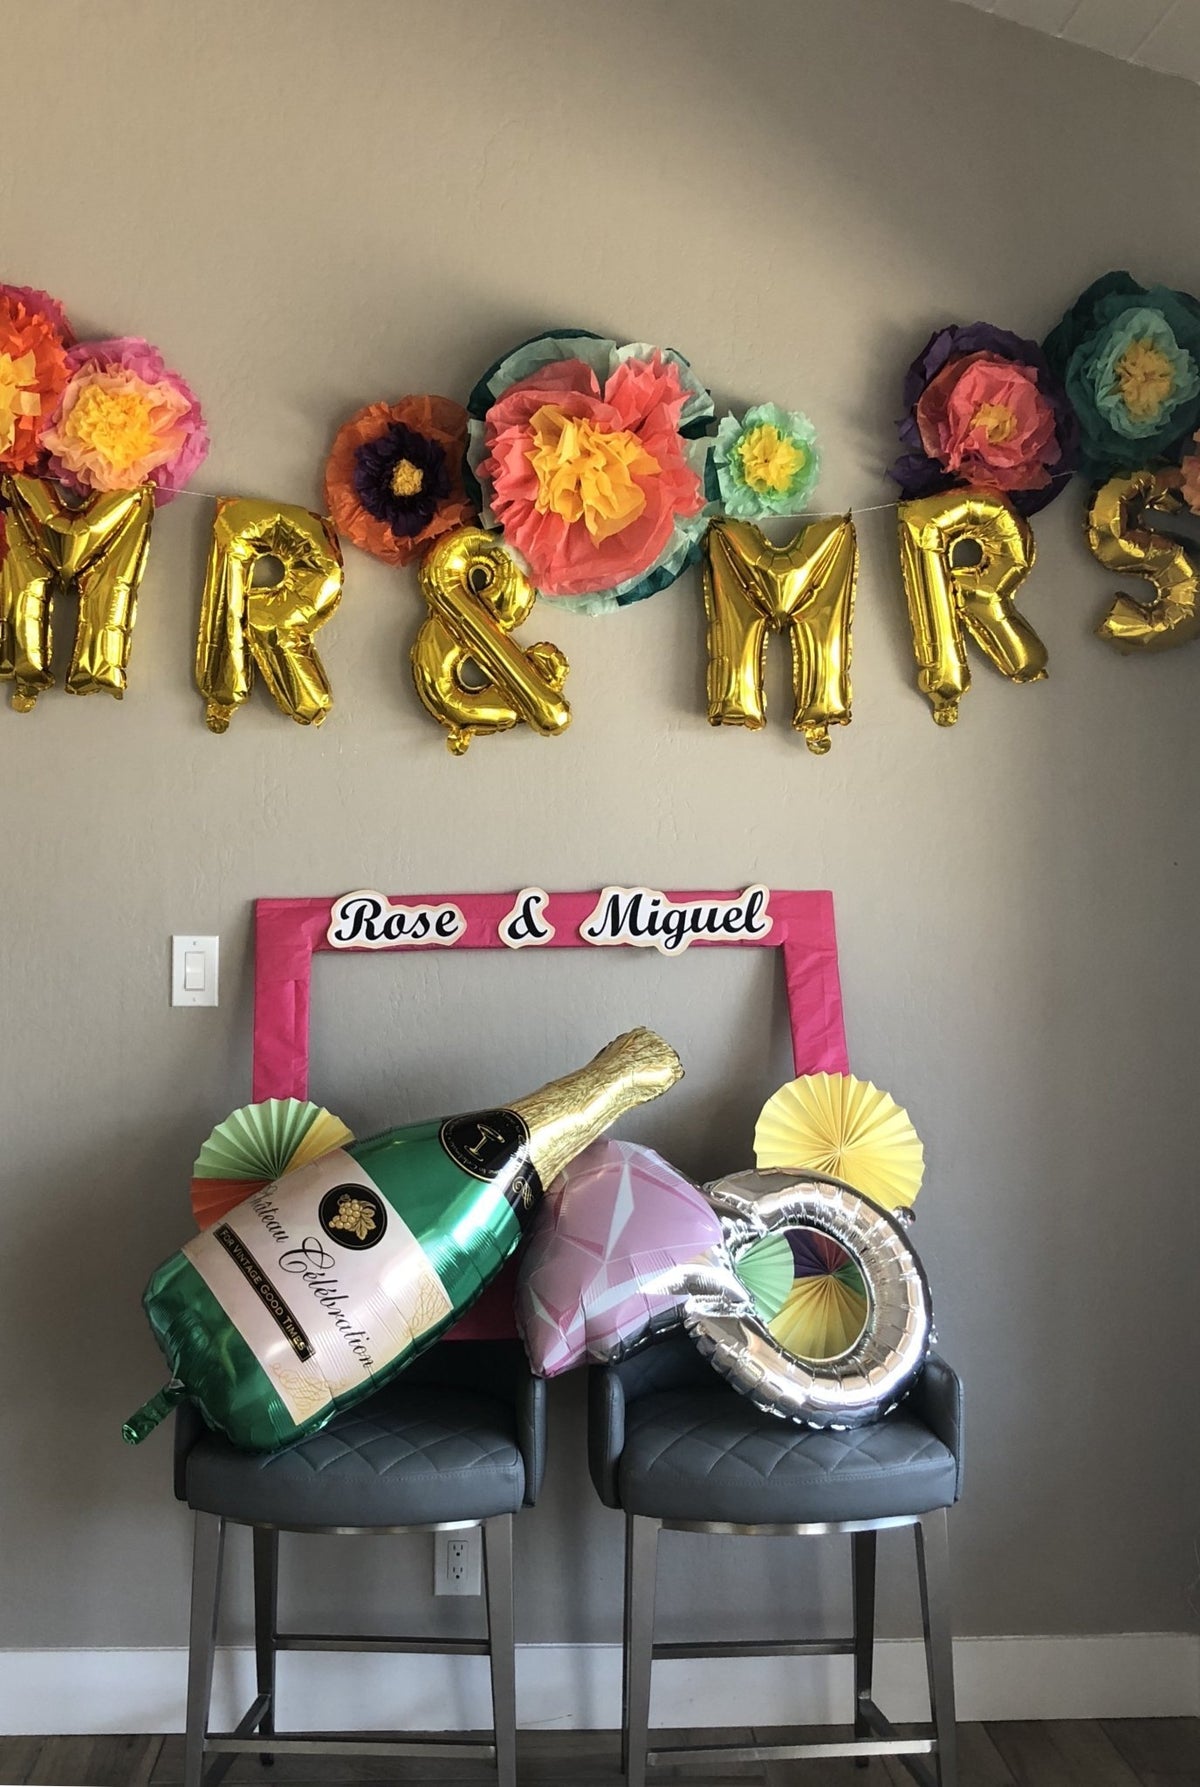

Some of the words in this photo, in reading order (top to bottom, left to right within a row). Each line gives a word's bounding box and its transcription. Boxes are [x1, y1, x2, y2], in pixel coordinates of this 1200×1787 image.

[0, 473, 345, 730] MR
[703, 470, 1200, 753] MRS
[334, 898, 459, 942] Rose
[507, 895, 549, 940] &
[587, 890, 767, 950] Miguel
[220, 1229, 235, 1248] FOR
[231, 1244, 262, 1285] VINTAGE
[260, 1282, 283, 1317] GOOD
[283, 1315, 306, 1351] TIMES
[278, 1236, 374, 1368] Célébration
